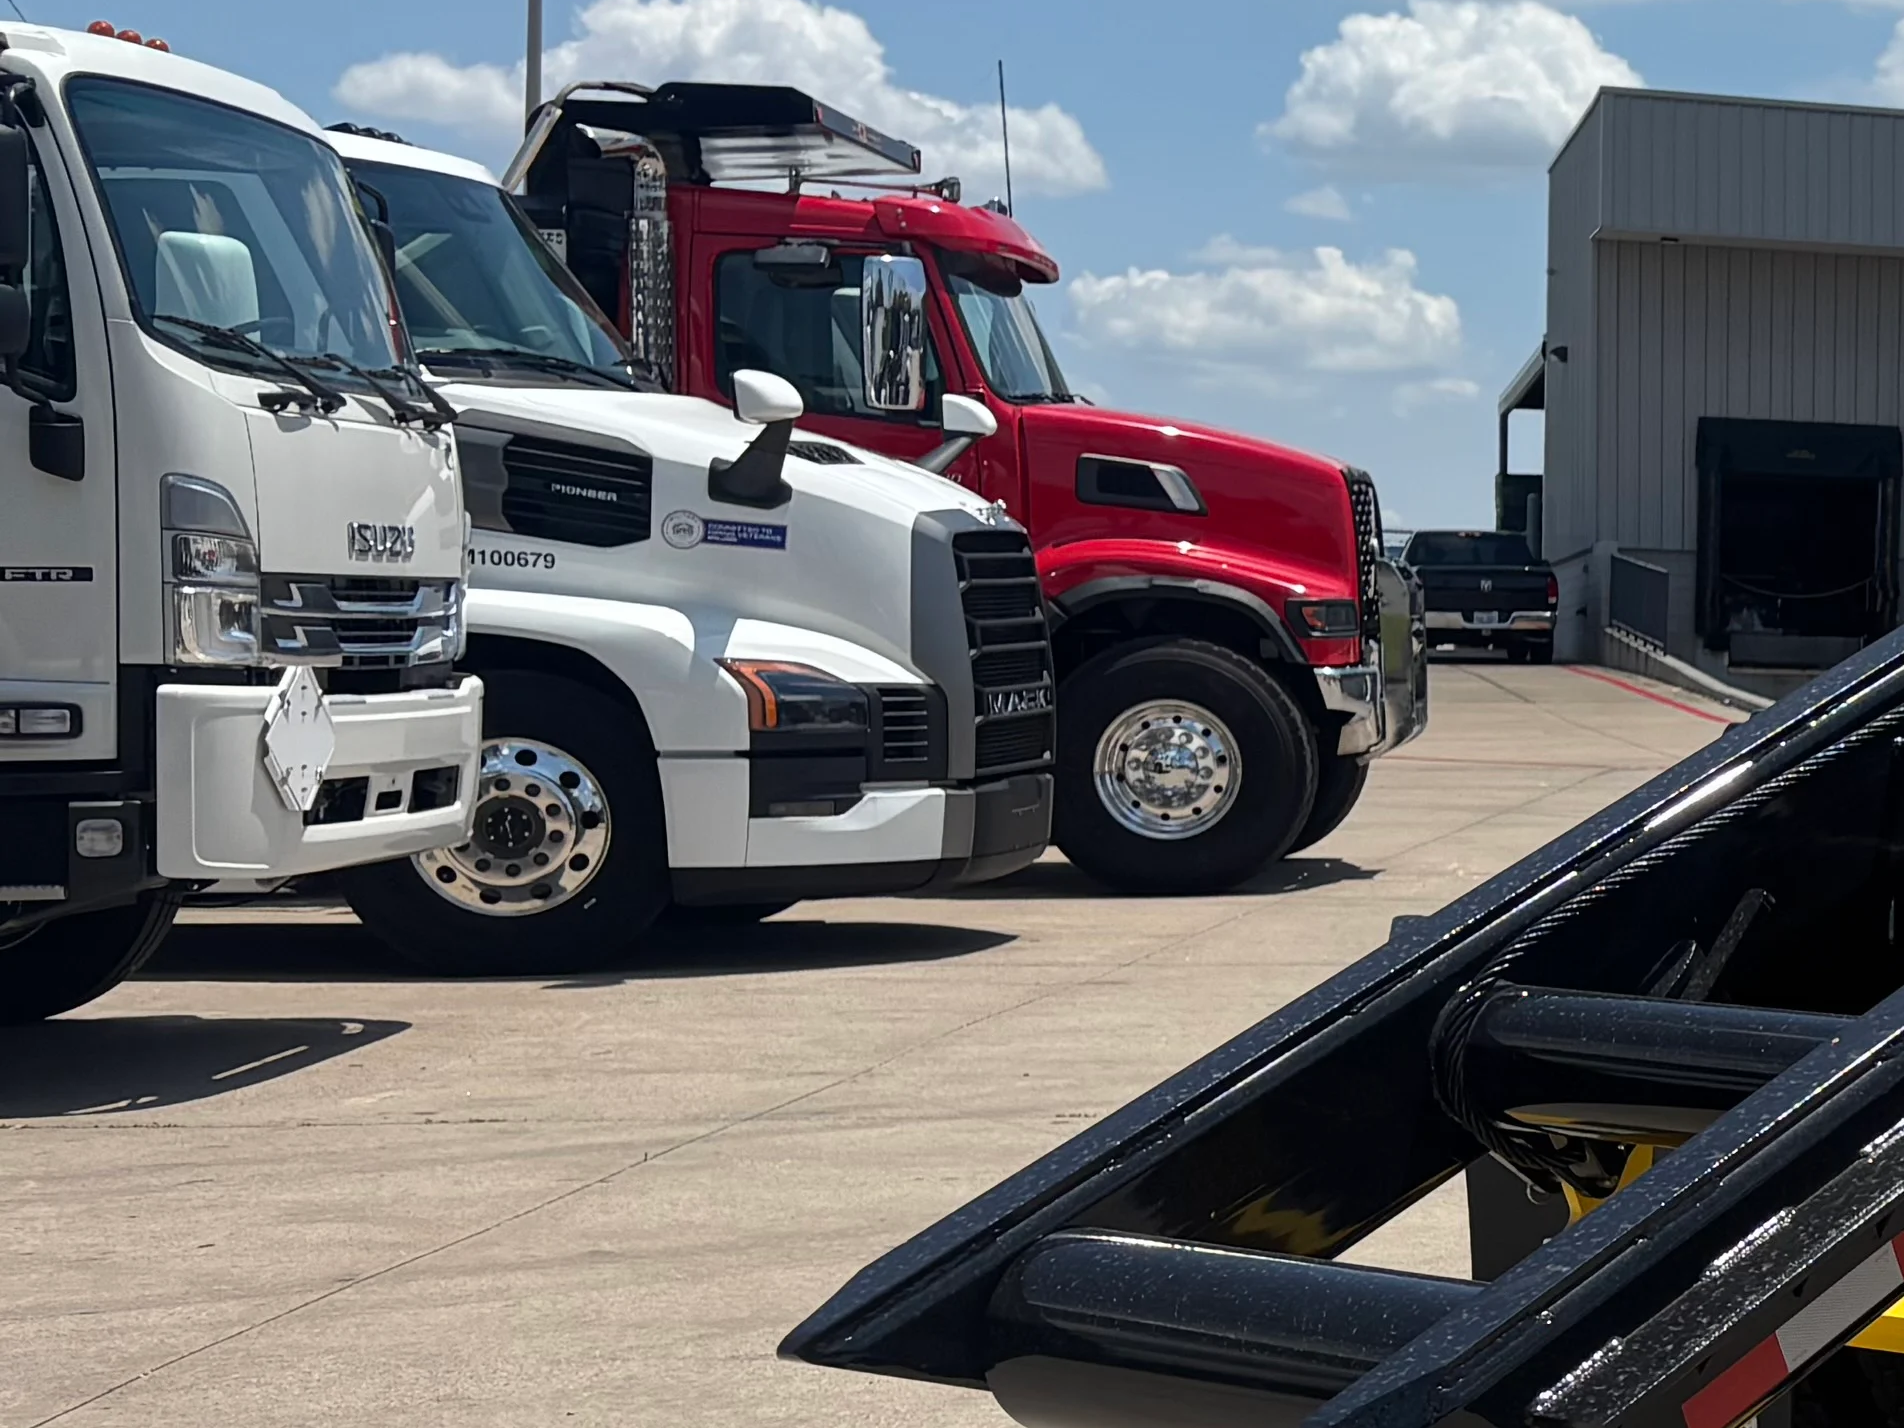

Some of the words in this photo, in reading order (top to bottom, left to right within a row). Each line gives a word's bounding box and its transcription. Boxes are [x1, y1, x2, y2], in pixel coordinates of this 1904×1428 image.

[551, 483, 617, 502] PIONEER
[347, 521, 415, 561] ISUZU
[5, 568, 74, 581] FTR
